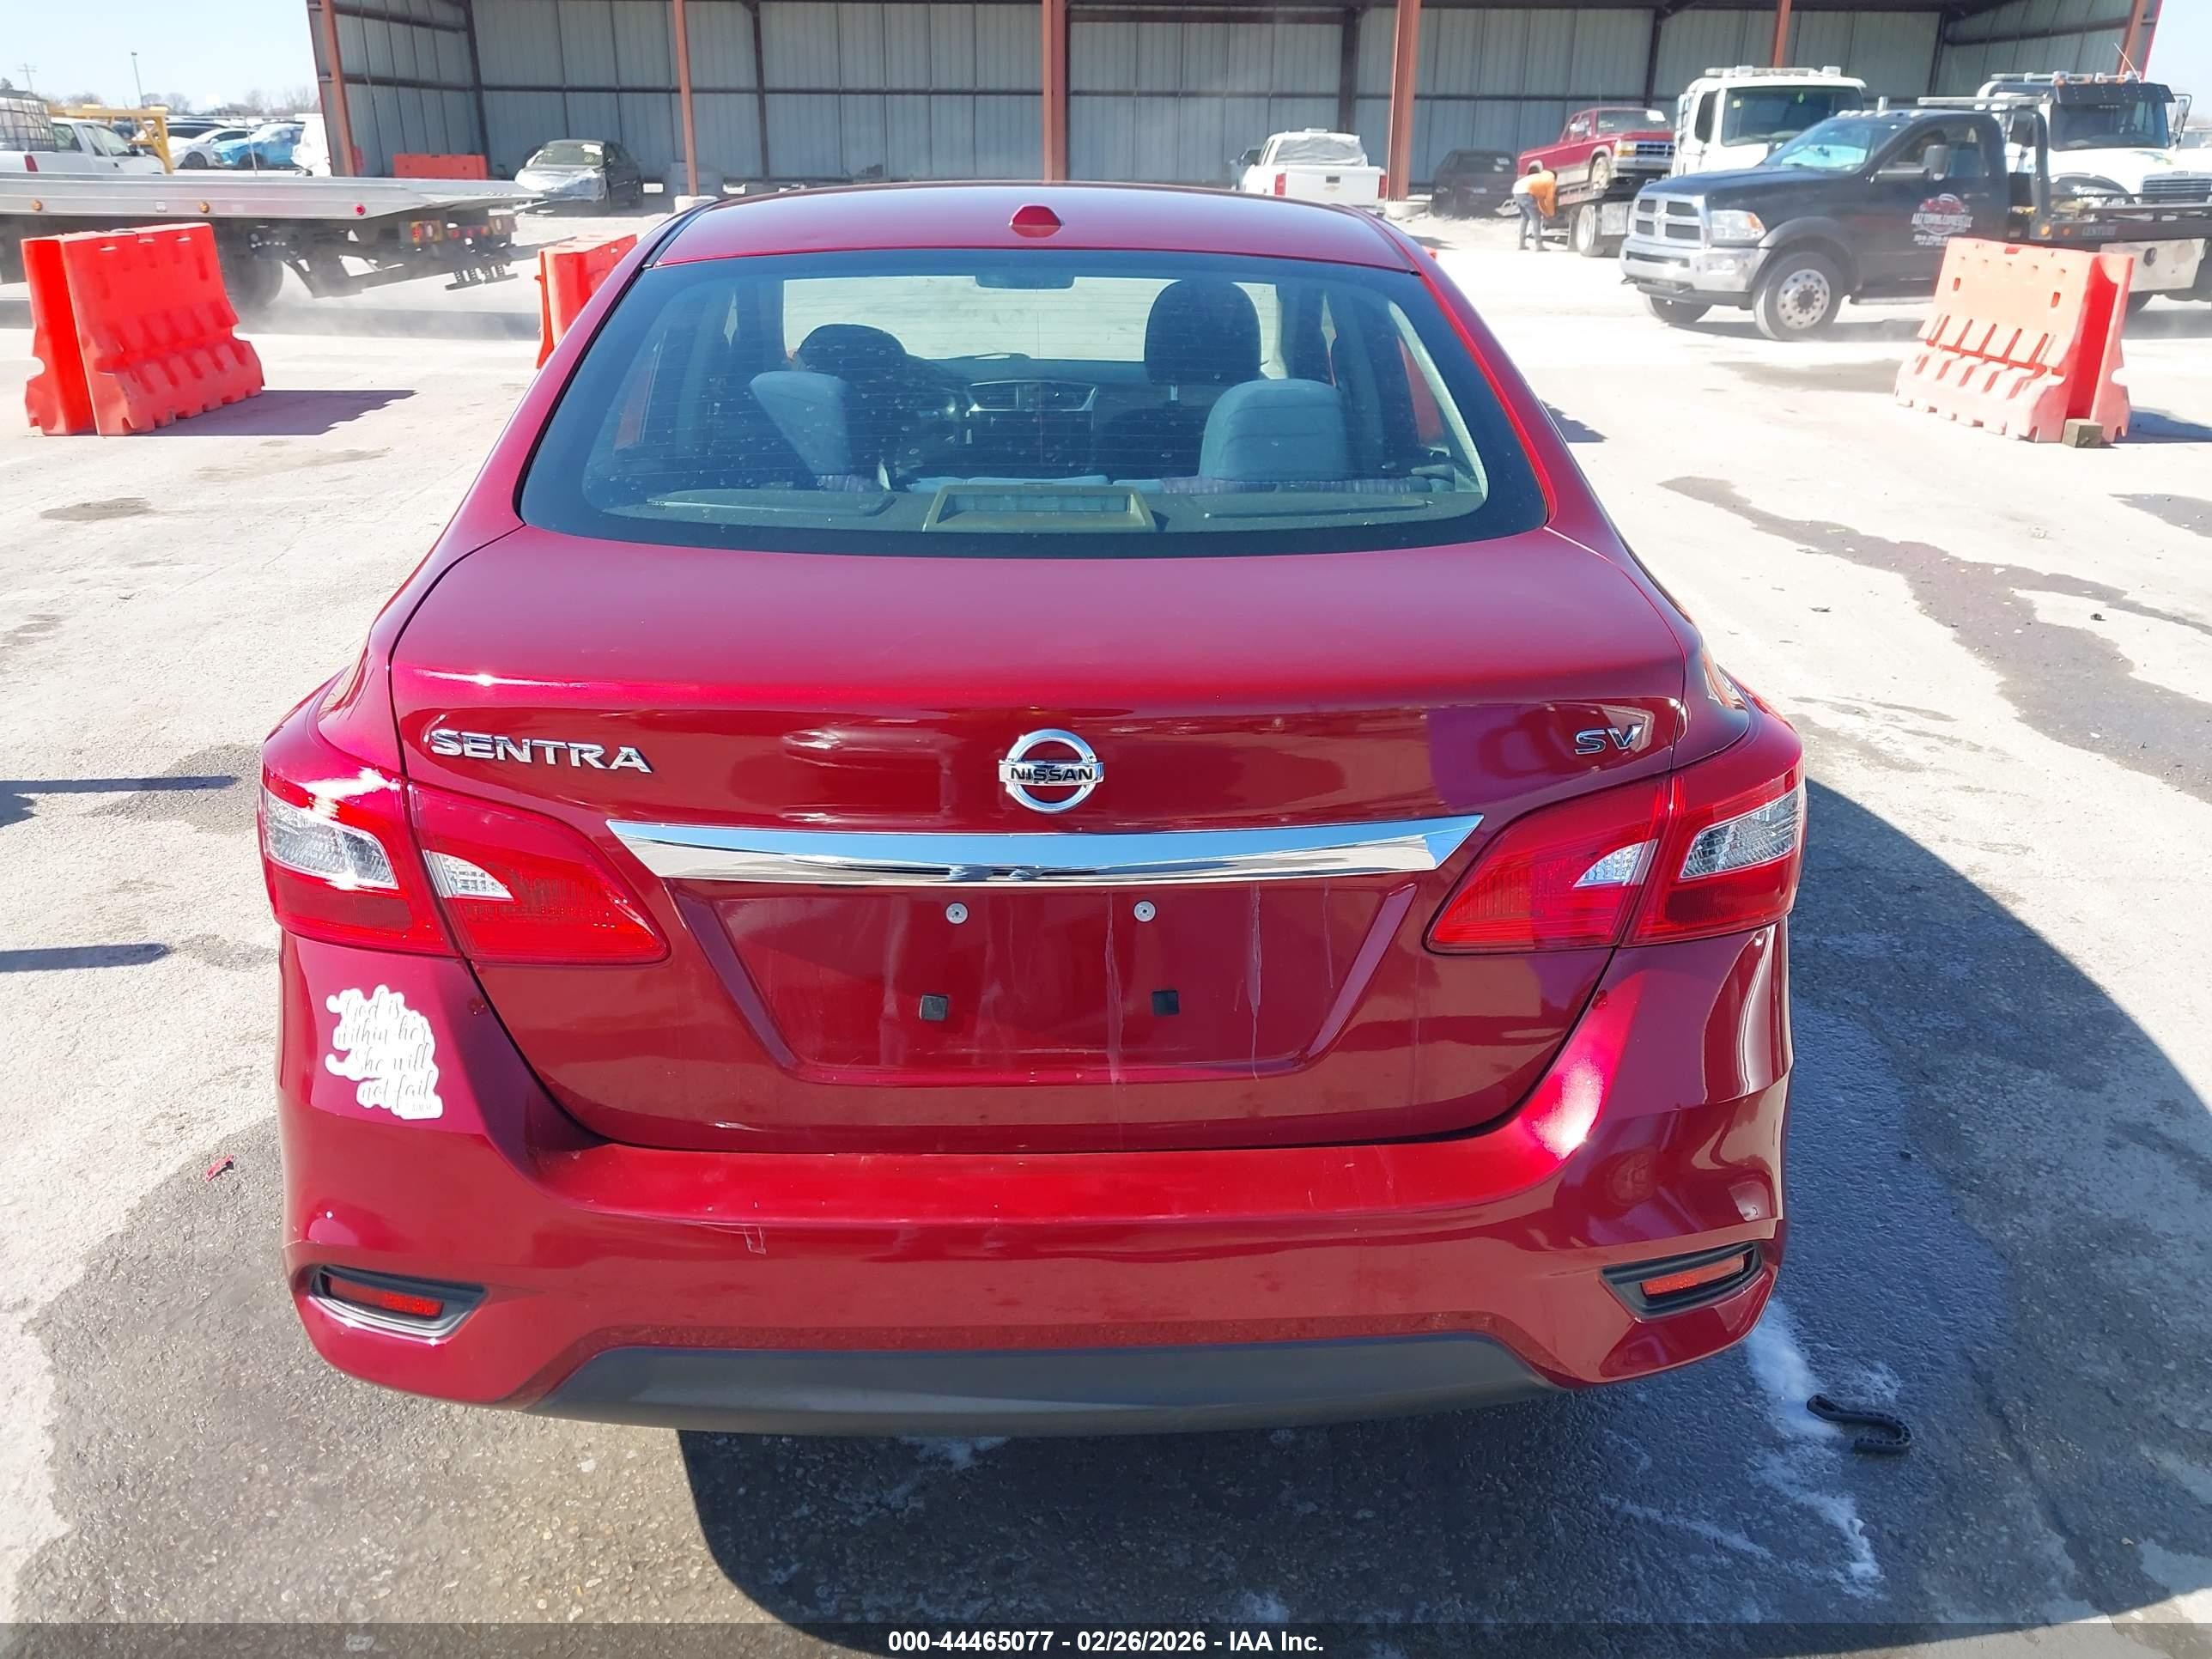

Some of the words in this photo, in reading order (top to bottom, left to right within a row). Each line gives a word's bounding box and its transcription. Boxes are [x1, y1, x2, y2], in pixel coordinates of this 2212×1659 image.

[430, 728, 653, 774] SENTRA
[1574, 724, 1644, 755] SV
[1010, 767, 1094, 782] NISSAN
[343, 991, 385, 1024] God
[387, 999, 400, 1020] is
[337, 1018, 389, 1045] within
[392, 1042, 432, 1073] will
[362, 1078, 390, 1103] not
